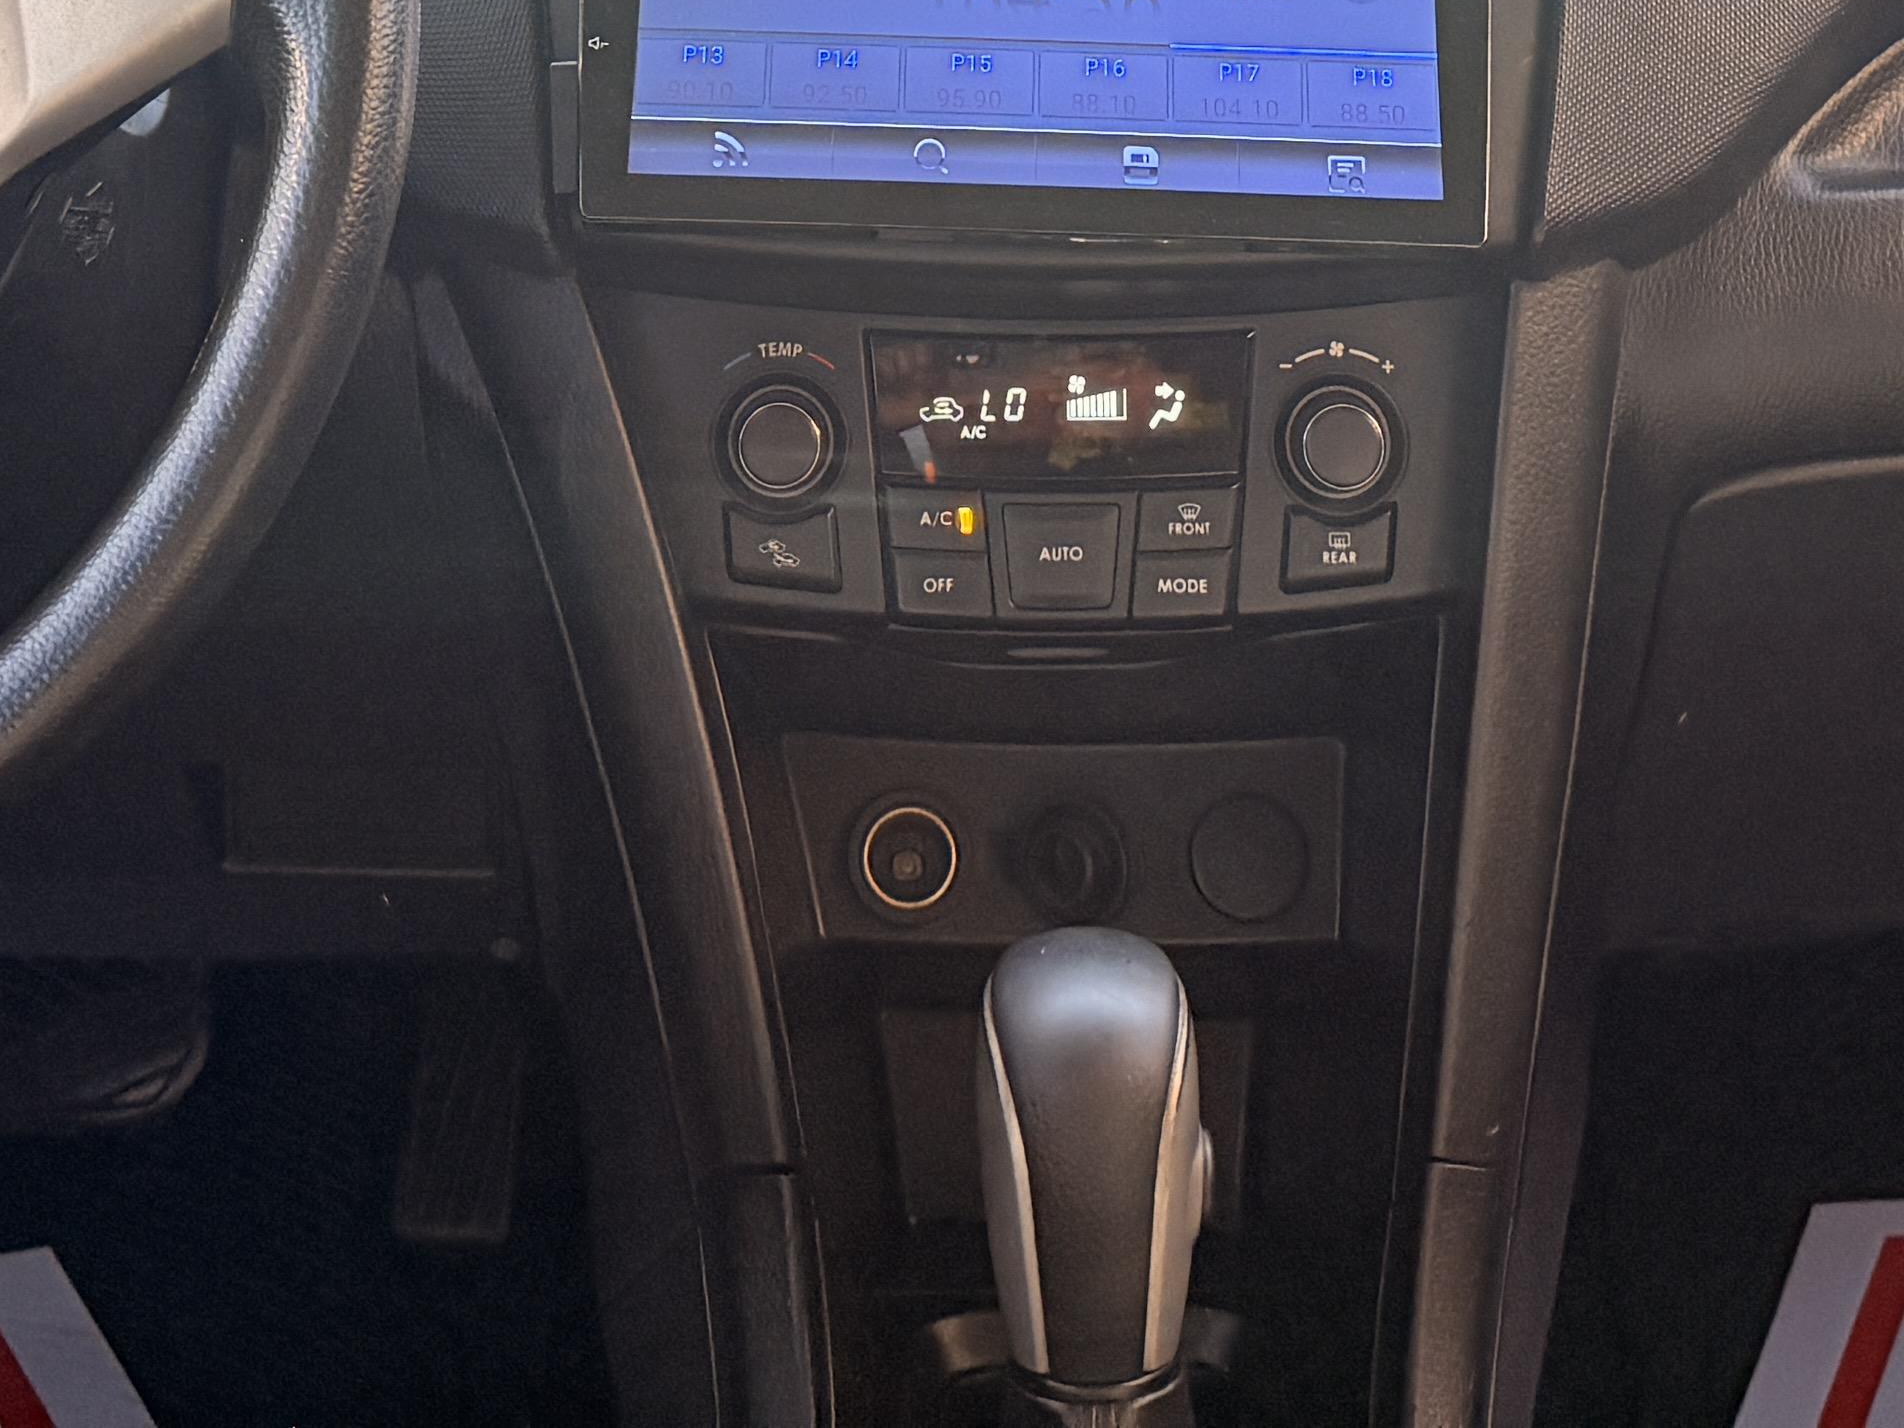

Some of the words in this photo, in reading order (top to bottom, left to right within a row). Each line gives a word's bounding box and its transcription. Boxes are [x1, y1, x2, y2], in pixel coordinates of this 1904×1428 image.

[682, 44, 726, 66] P13
[816, 48, 859, 70] P14
[950, 53, 992, 74] P15
[1084, 57, 1127, 78] P16
[1218, 62, 1261, 83] P17
[1352, 67, 1394, 88] P18
[757, 342, 803, 358] TEMP
[980, 387, 1028, 422] LO
[960, 425, 987, 439] A/C
[920, 510, 953, 527] A/C
[1168, 522, 1211, 536] FRONT
[1039, 546, 1084, 562] AUTO
[1322, 550, 1357, 565] REAR
[923, 578, 954, 593] OFF
[1157, 578, 1209, 594] MODE
